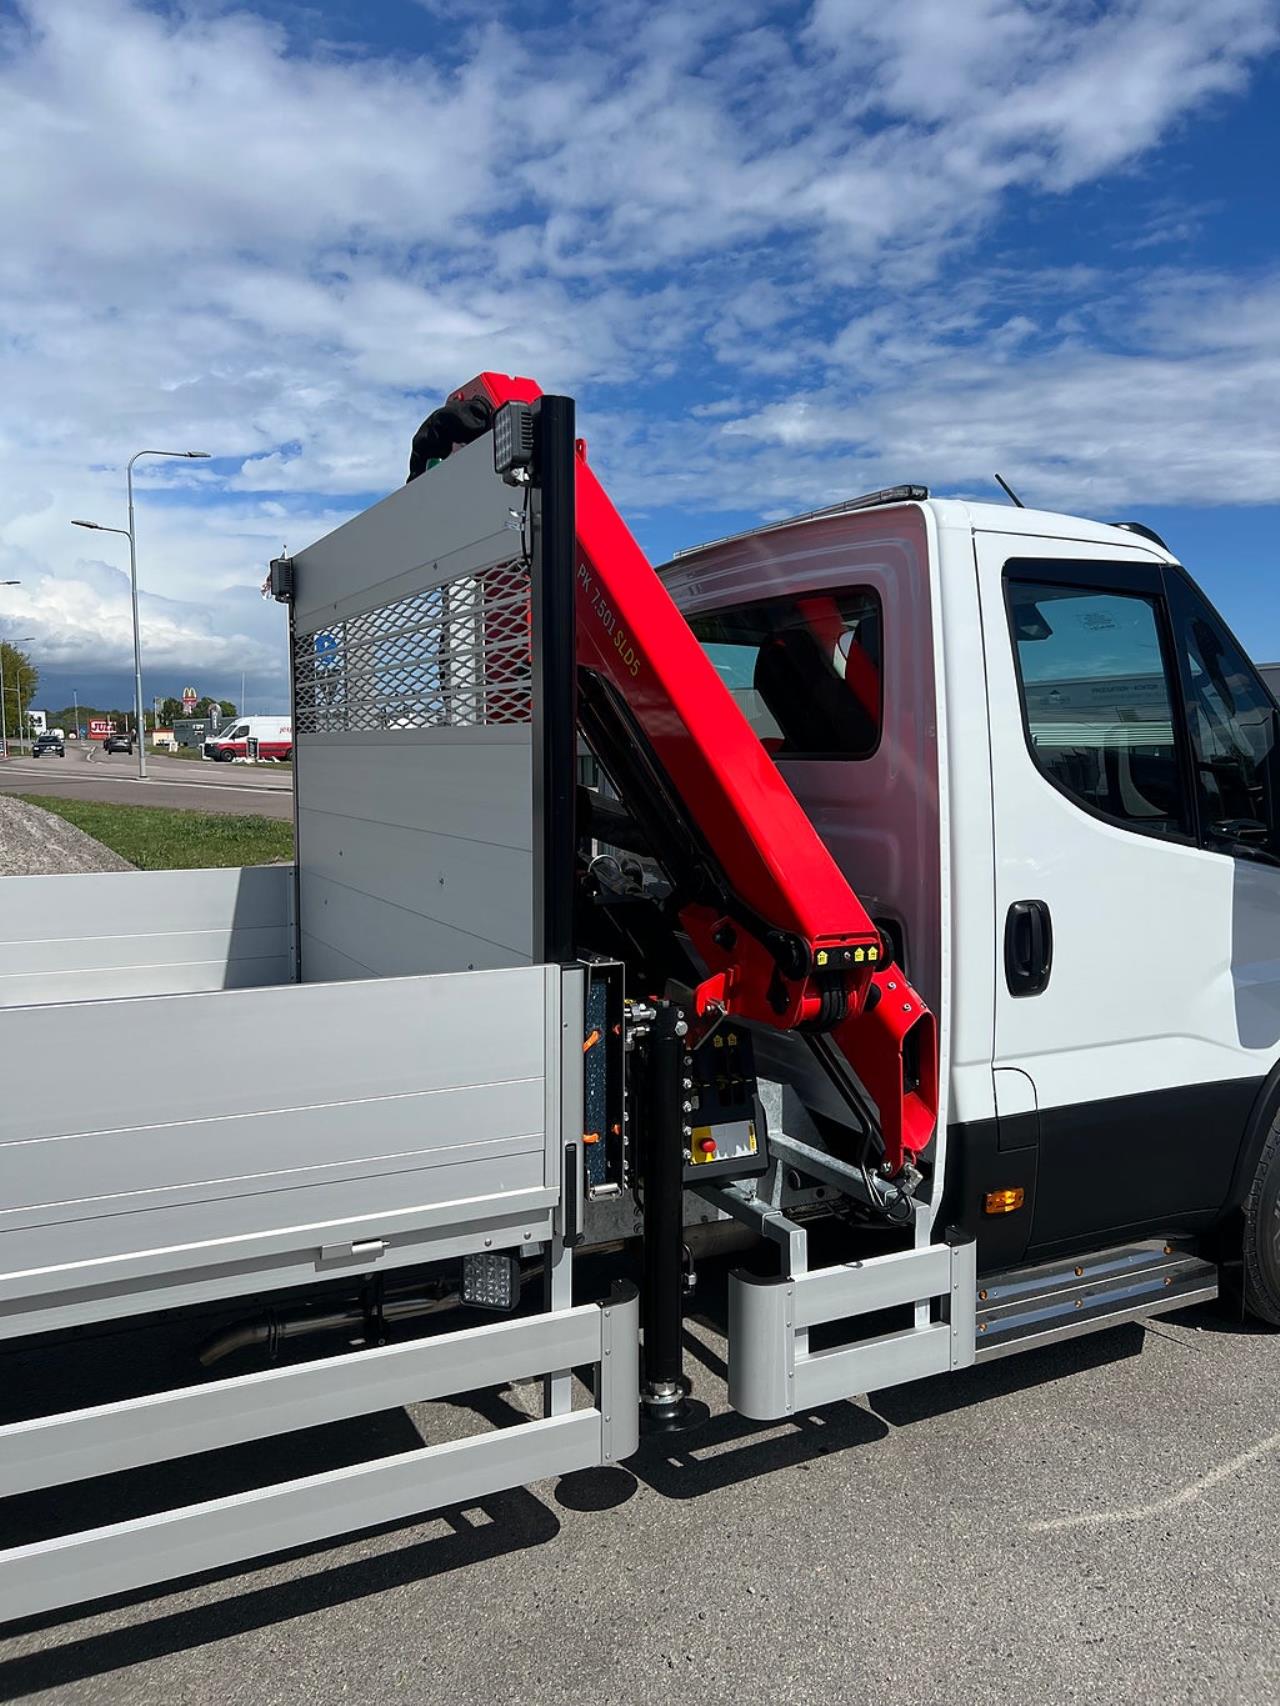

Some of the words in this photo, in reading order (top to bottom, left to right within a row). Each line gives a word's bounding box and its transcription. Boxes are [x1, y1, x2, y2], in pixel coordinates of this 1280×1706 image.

[577, 563, 592, 592] PK
[591, 587, 616, 636] 7.501
[614, 629, 641, 677] SLD5
